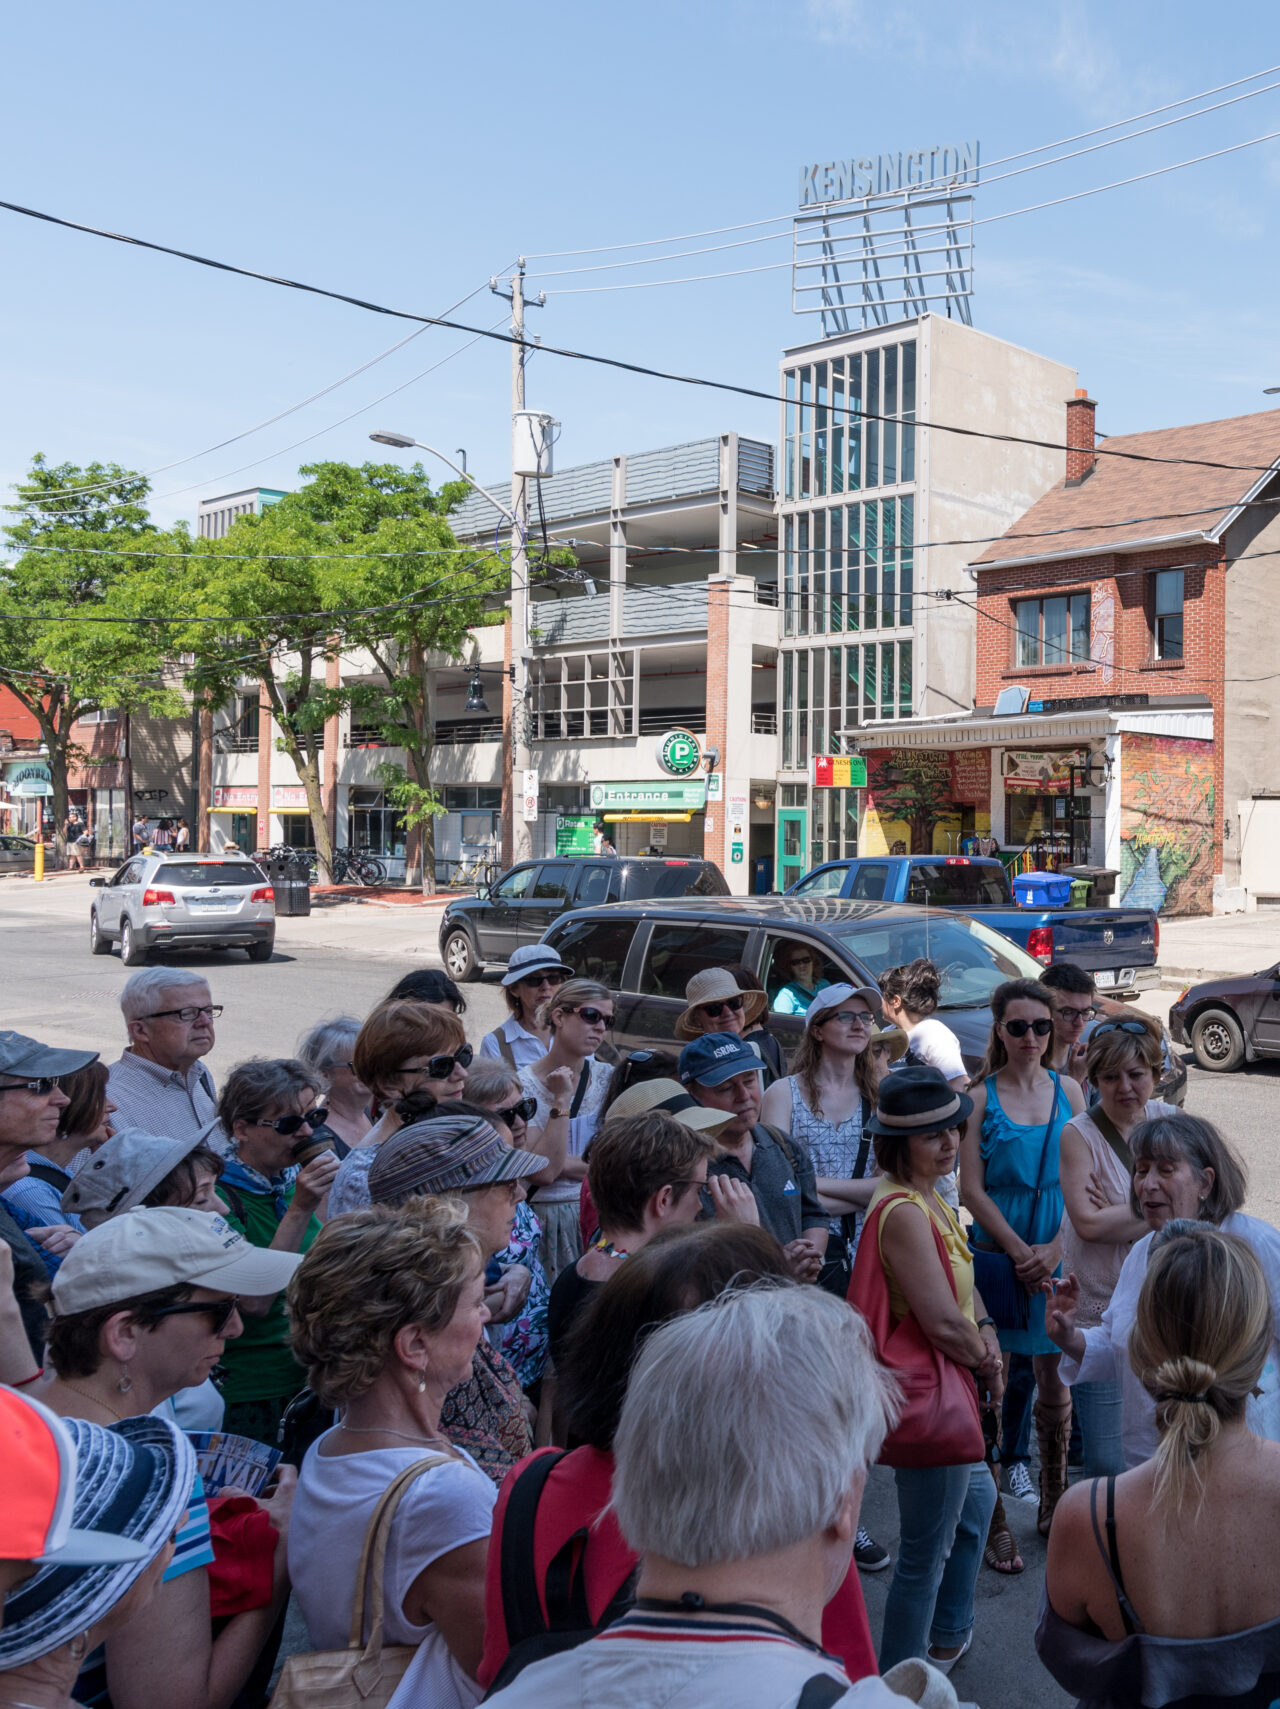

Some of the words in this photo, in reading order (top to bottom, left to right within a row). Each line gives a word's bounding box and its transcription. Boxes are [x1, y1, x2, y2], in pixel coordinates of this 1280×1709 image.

[799, 140, 980, 206] KENSINGTON
[663, 734, 699, 753] MUNICIPAL
[675, 743, 690, 760] P
[663, 756, 698, 774] PARKING
[607, 790, 669, 801] Entrance
[713, 1043, 741, 1059] ISRAEL
